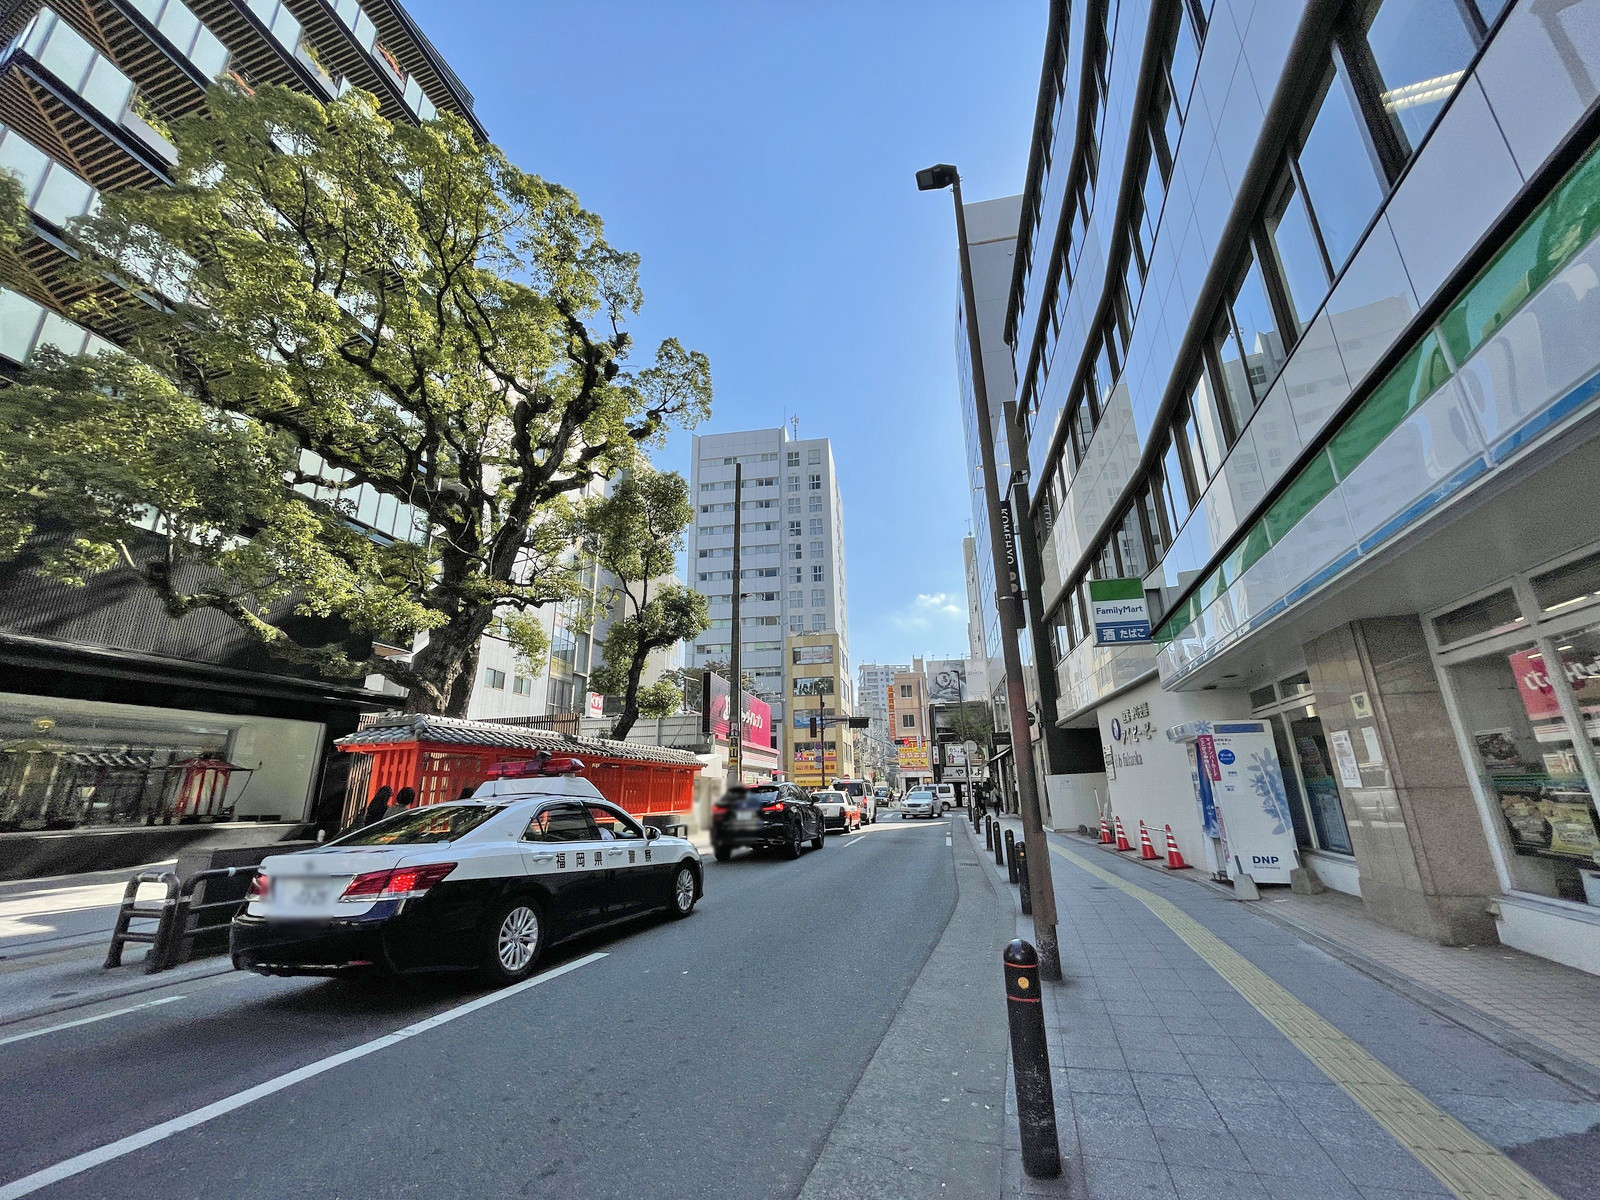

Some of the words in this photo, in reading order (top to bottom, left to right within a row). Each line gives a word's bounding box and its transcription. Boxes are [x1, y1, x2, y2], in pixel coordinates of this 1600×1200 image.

[1096, 605, 1143, 615] FamilyMart
[1102, 628, 1116, 641] 酒
[1119, 628, 1146, 639] たばこ
[556, 851, 603, 869] 福岡県
[628, 849, 652, 864] 警察
[1252, 856, 1279, 864] DNP
